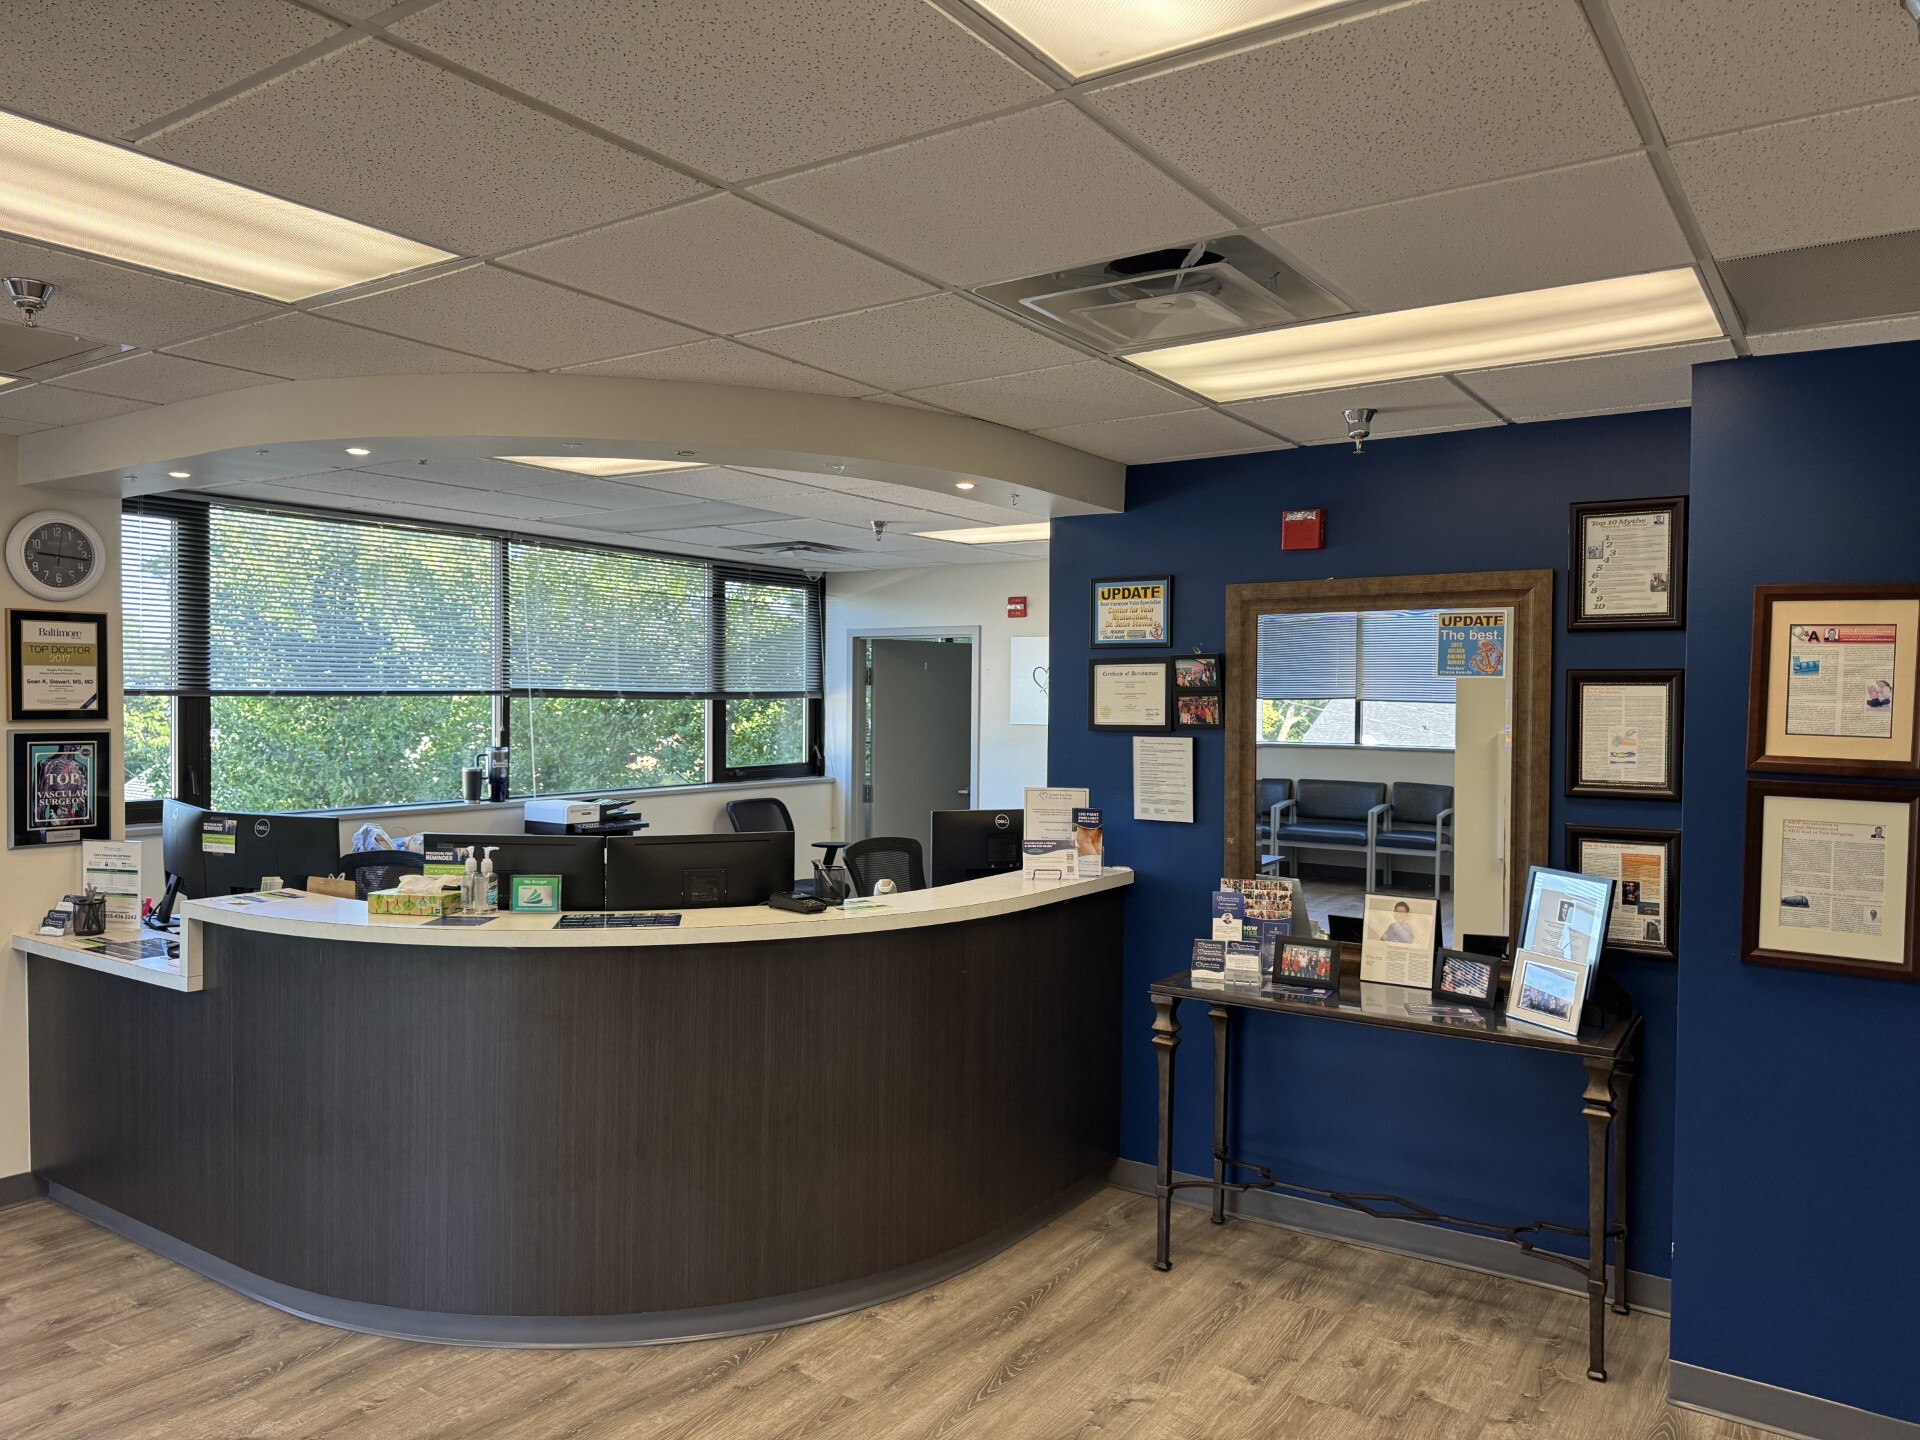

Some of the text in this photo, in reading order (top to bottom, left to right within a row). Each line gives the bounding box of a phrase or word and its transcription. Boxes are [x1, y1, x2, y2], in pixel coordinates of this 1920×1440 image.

[41, 530, 48, 541] 11
[52, 527, 62, 537] 12
[31, 539, 41, 549] 10
[77, 540, 83, 551] 2
[27, 550, 34, 560] 9
[32, 561, 39, 572] 8
[78, 562, 84, 572] 4
[43, 570, 50, 580] 7
[55, 573, 62, 583] 6
[69, 570, 75, 579] 5
[1101, 586, 1161, 600] UPDATE
[1441, 615, 1504, 627] UPDATE
[39, 627, 82, 637] Baltimore
[1440, 629, 1502, 640] The best.
[29, 645, 91, 655] TOP DOCTOR
[49, 654, 71, 663] 2017
[46, 773, 80, 785] TOP
[37, 789, 88, 799] VASCULAR
[39, 797, 86, 806] SURGEON
